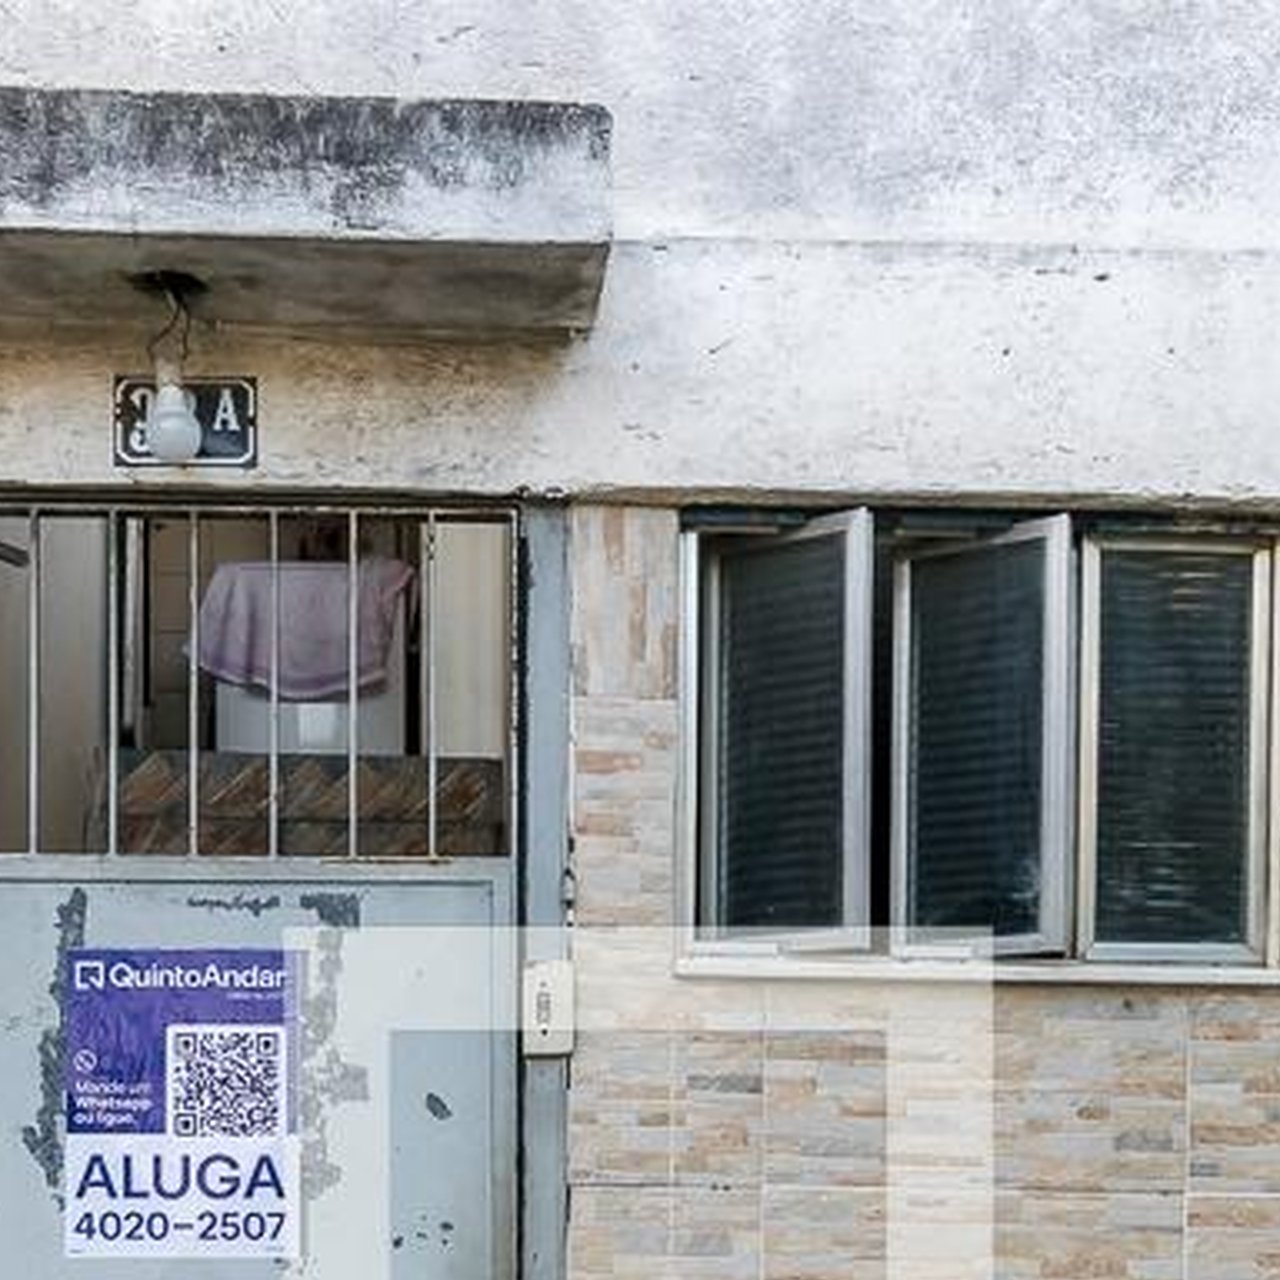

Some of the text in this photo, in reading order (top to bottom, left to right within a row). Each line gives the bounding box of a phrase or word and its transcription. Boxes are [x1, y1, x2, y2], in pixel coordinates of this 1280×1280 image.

[213, 388, 241, 430] A
[109, 963, 290, 990] QuintoAndar
[73, 1112, 93, 1125] ou
[76, 1154, 286, 1199] ALUGA
[74, 1211, 287, 1241] 4020-2507
